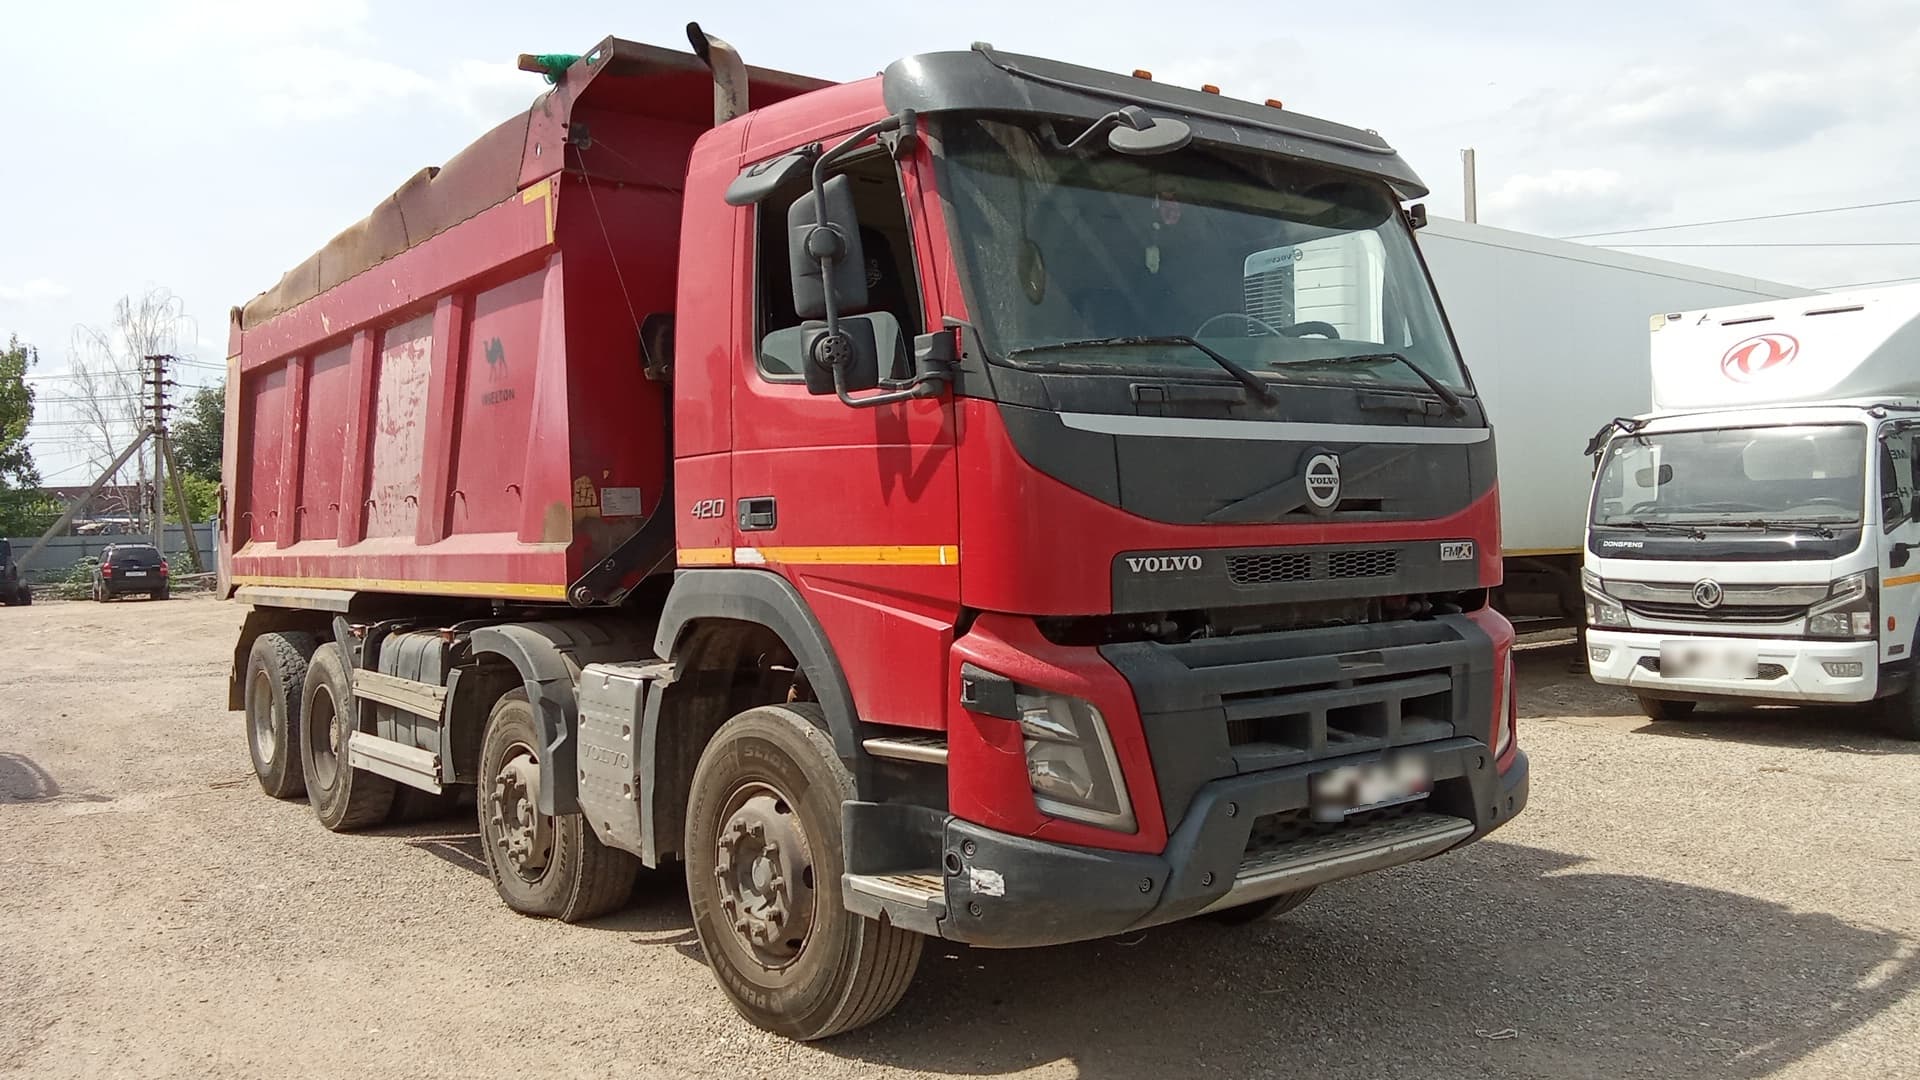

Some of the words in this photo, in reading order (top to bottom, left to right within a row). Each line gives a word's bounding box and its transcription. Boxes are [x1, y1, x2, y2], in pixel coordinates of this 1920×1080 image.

[1307, 477, 1339, 485] VOLVO
[690, 499, 726, 519] 420
[1442, 543, 1472, 559] FMX
[1603, 540, 1644, 548] DONGFENG
[1125, 555, 1202, 573] VOLVO
[581, 742, 630, 769] VOLVO
